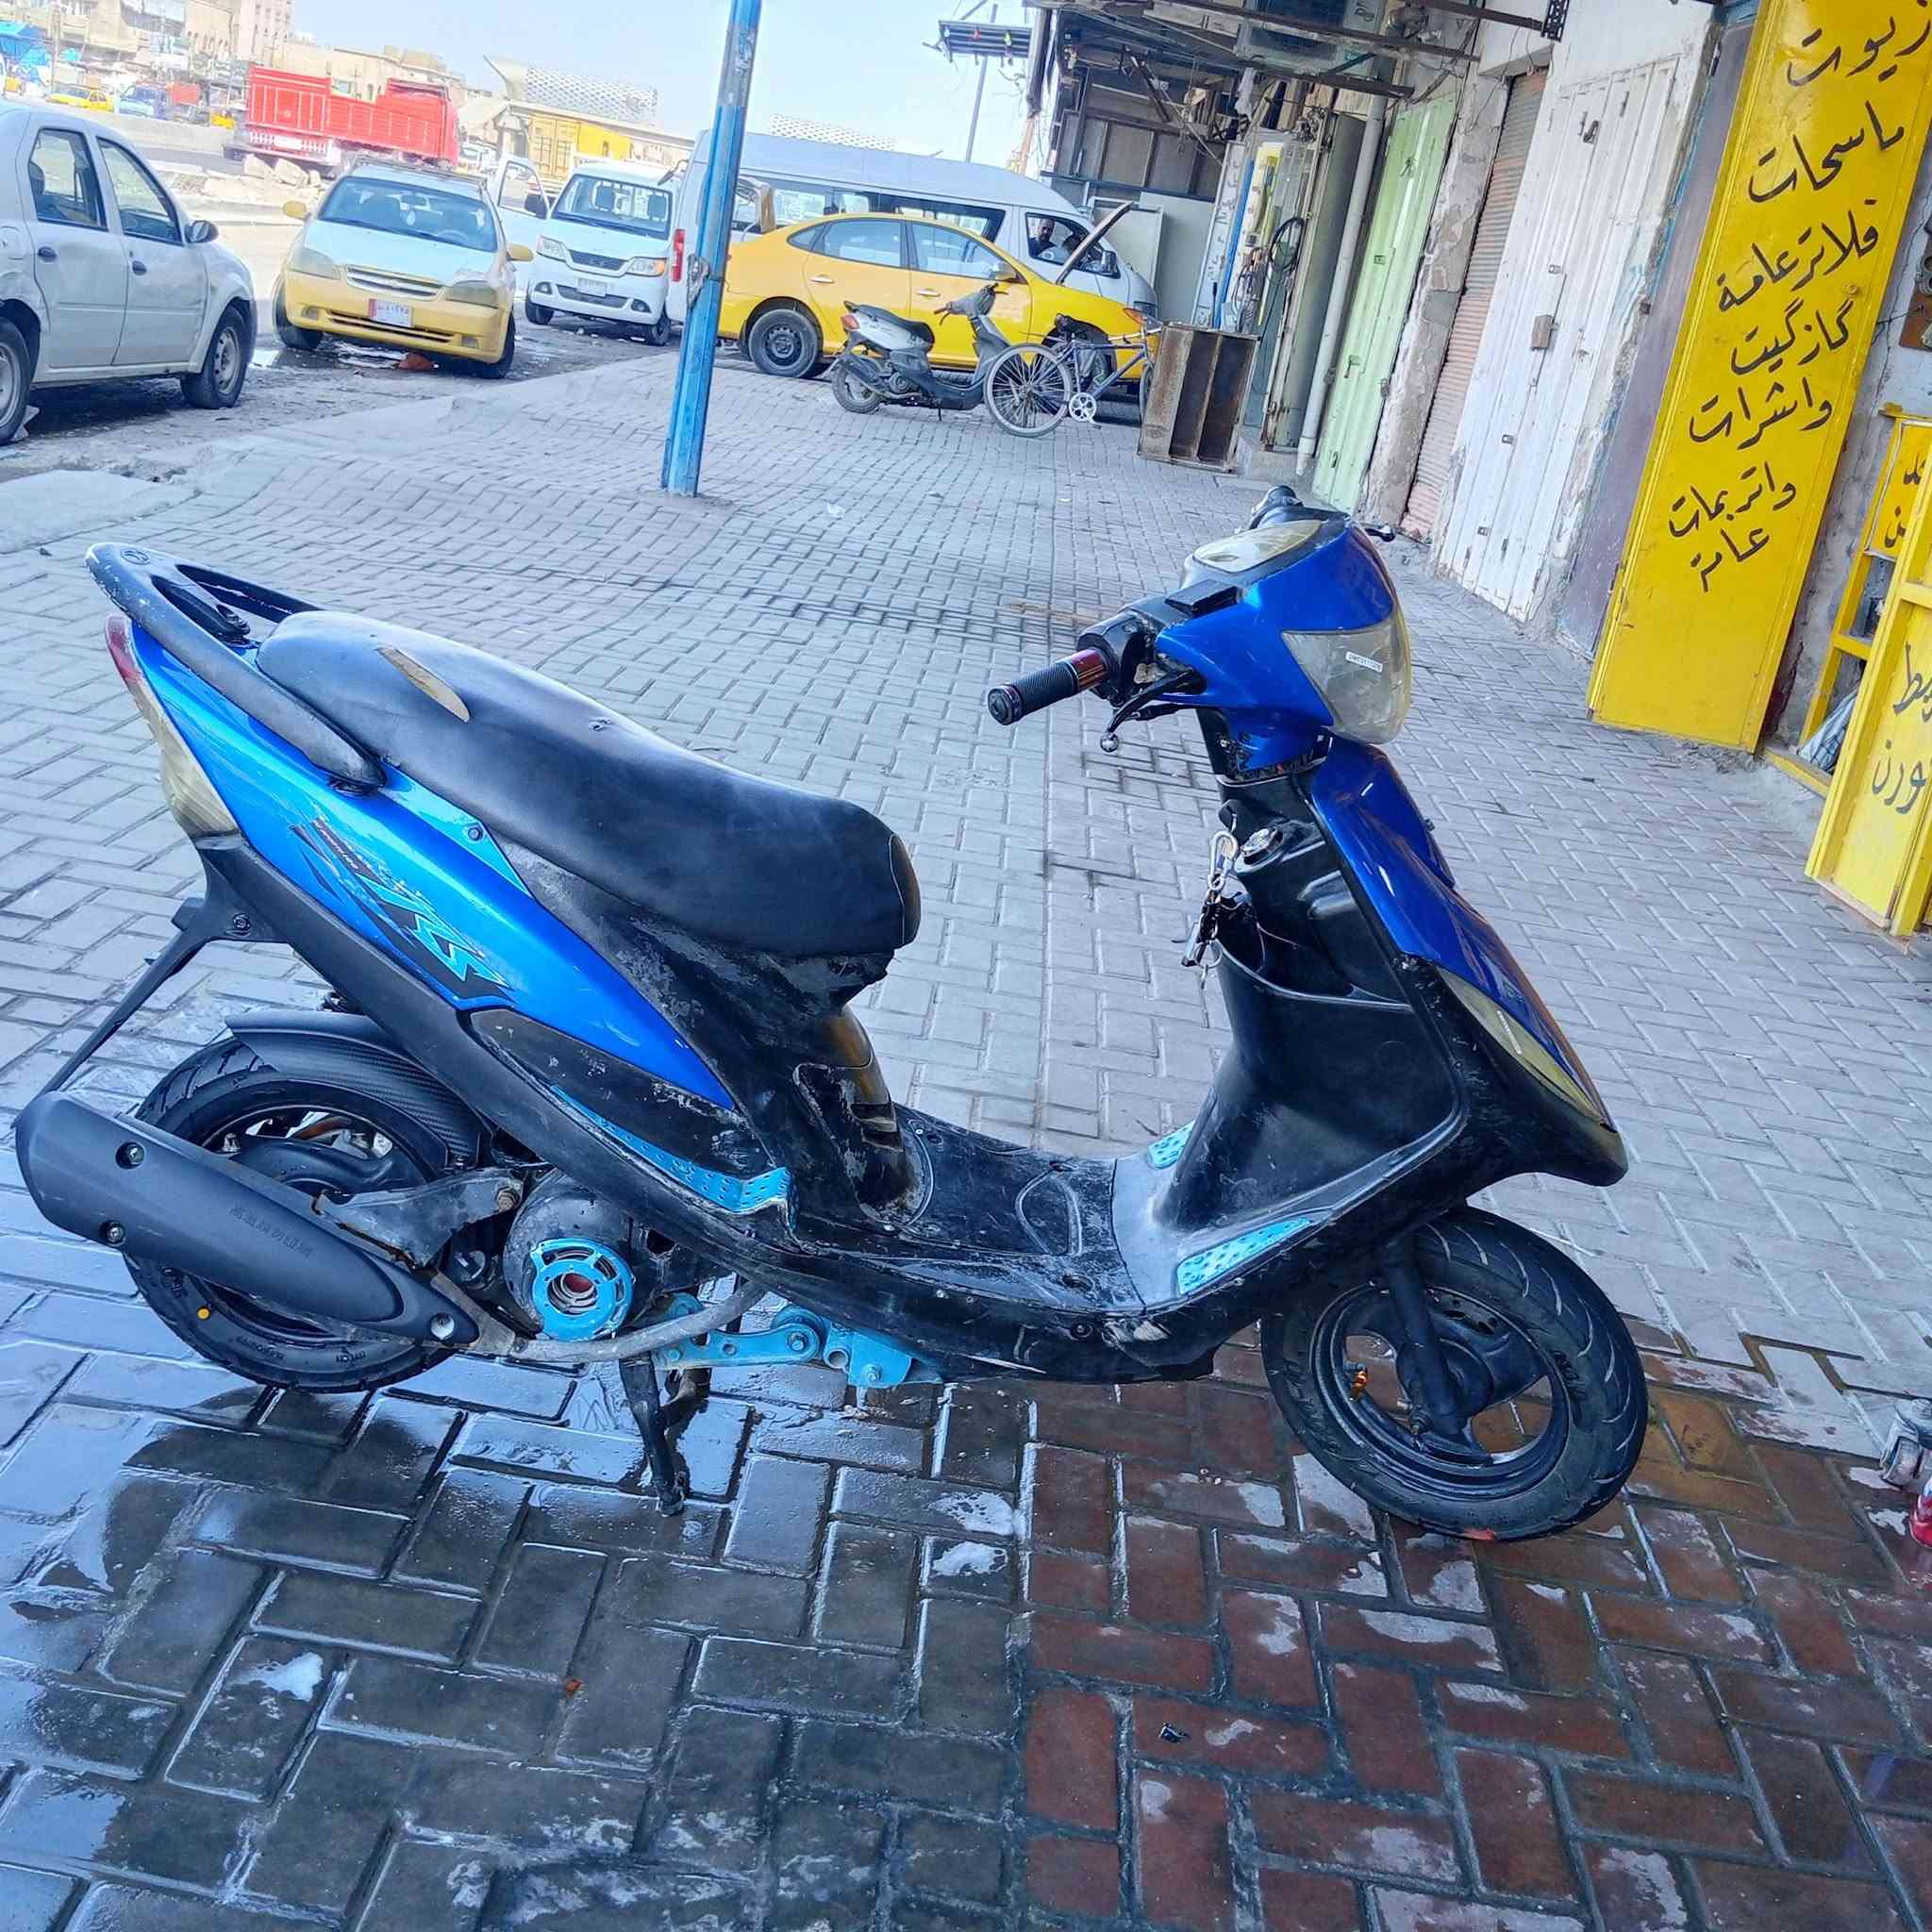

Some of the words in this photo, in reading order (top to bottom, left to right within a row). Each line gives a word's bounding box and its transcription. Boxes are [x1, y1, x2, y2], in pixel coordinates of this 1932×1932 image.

[1787, 0, 1931, 87] زيوت
[1748, 100, 1905, 203] ماسحات
[1718, 242, 1799, 311] عامة
[1690, 376, 1833, 451] واشرات
[1690, 527, 1770, 592] عامة
